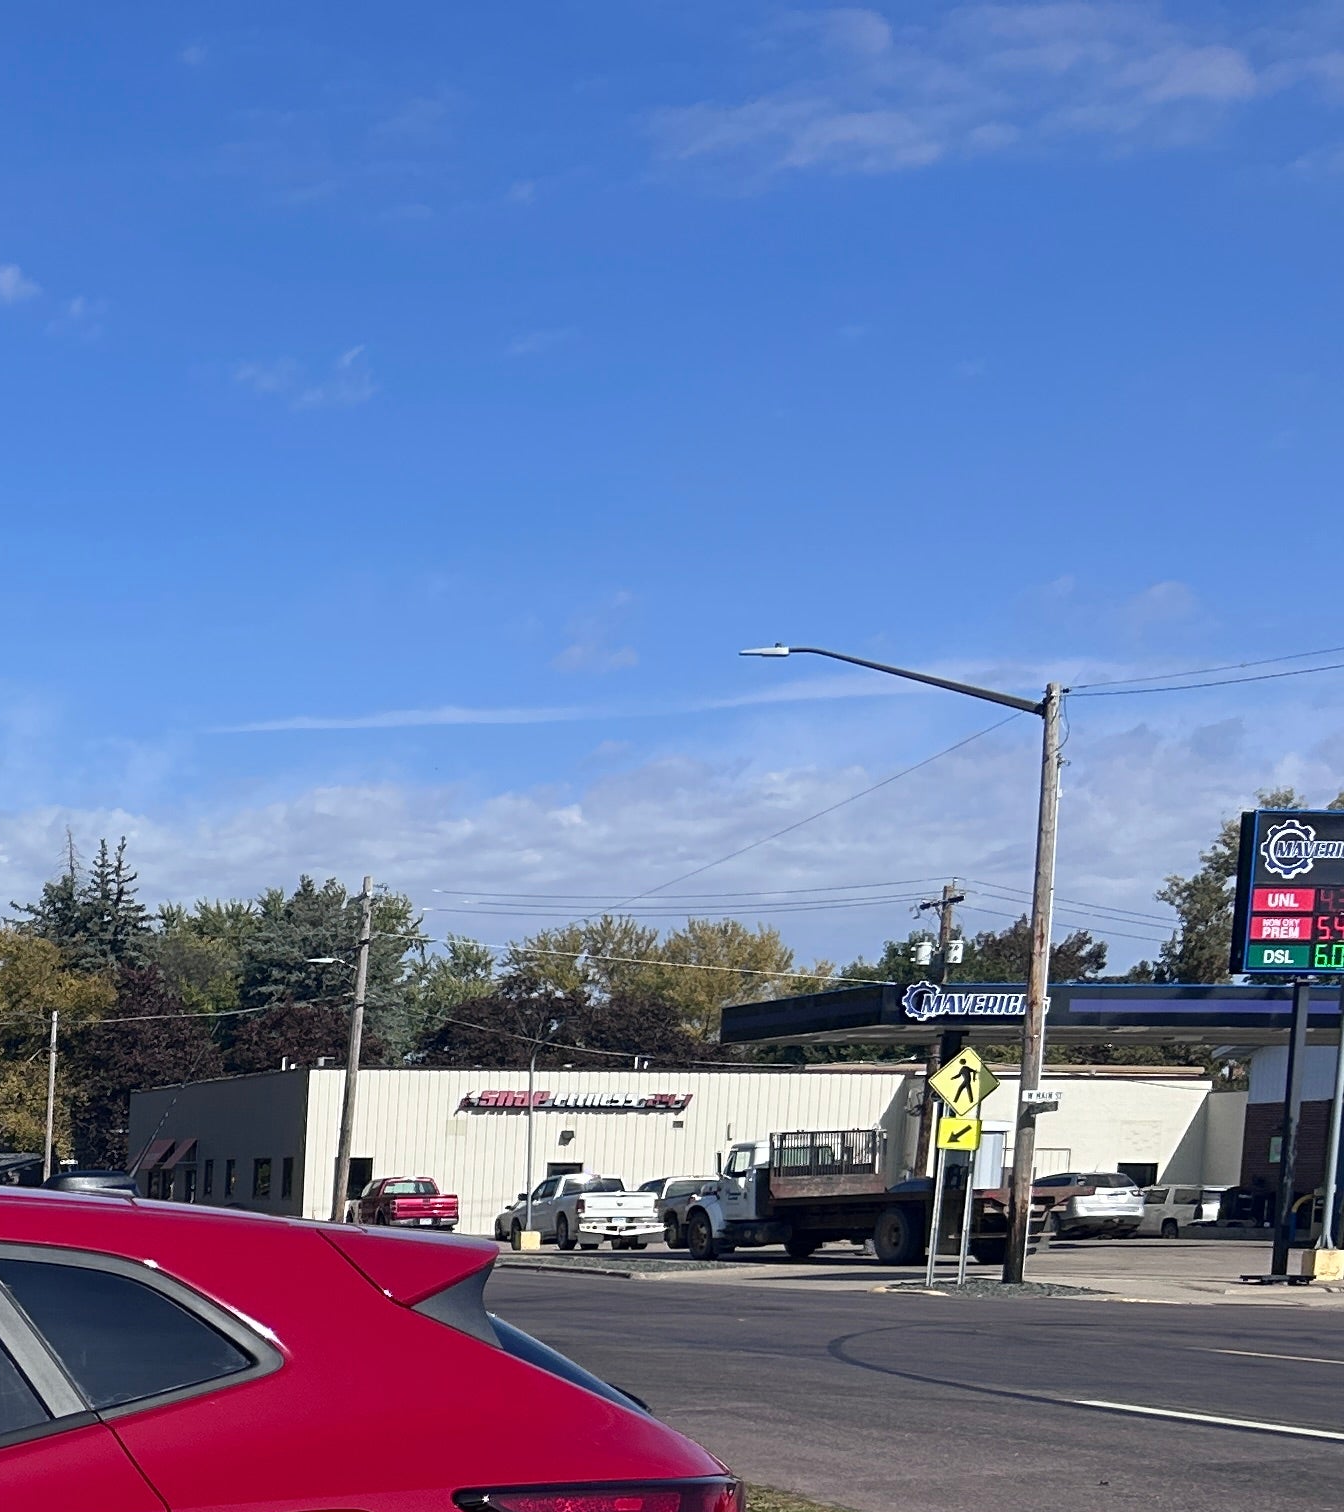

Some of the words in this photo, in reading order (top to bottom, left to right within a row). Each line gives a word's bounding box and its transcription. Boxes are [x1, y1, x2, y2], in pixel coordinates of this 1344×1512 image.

[1275, 840, 1344, 858] MAVERI
[1267, 892, 1300, 908] UNL
[1262, 926, 1300, 939] PREM
[1263, 949, 1294, 964] DSL
